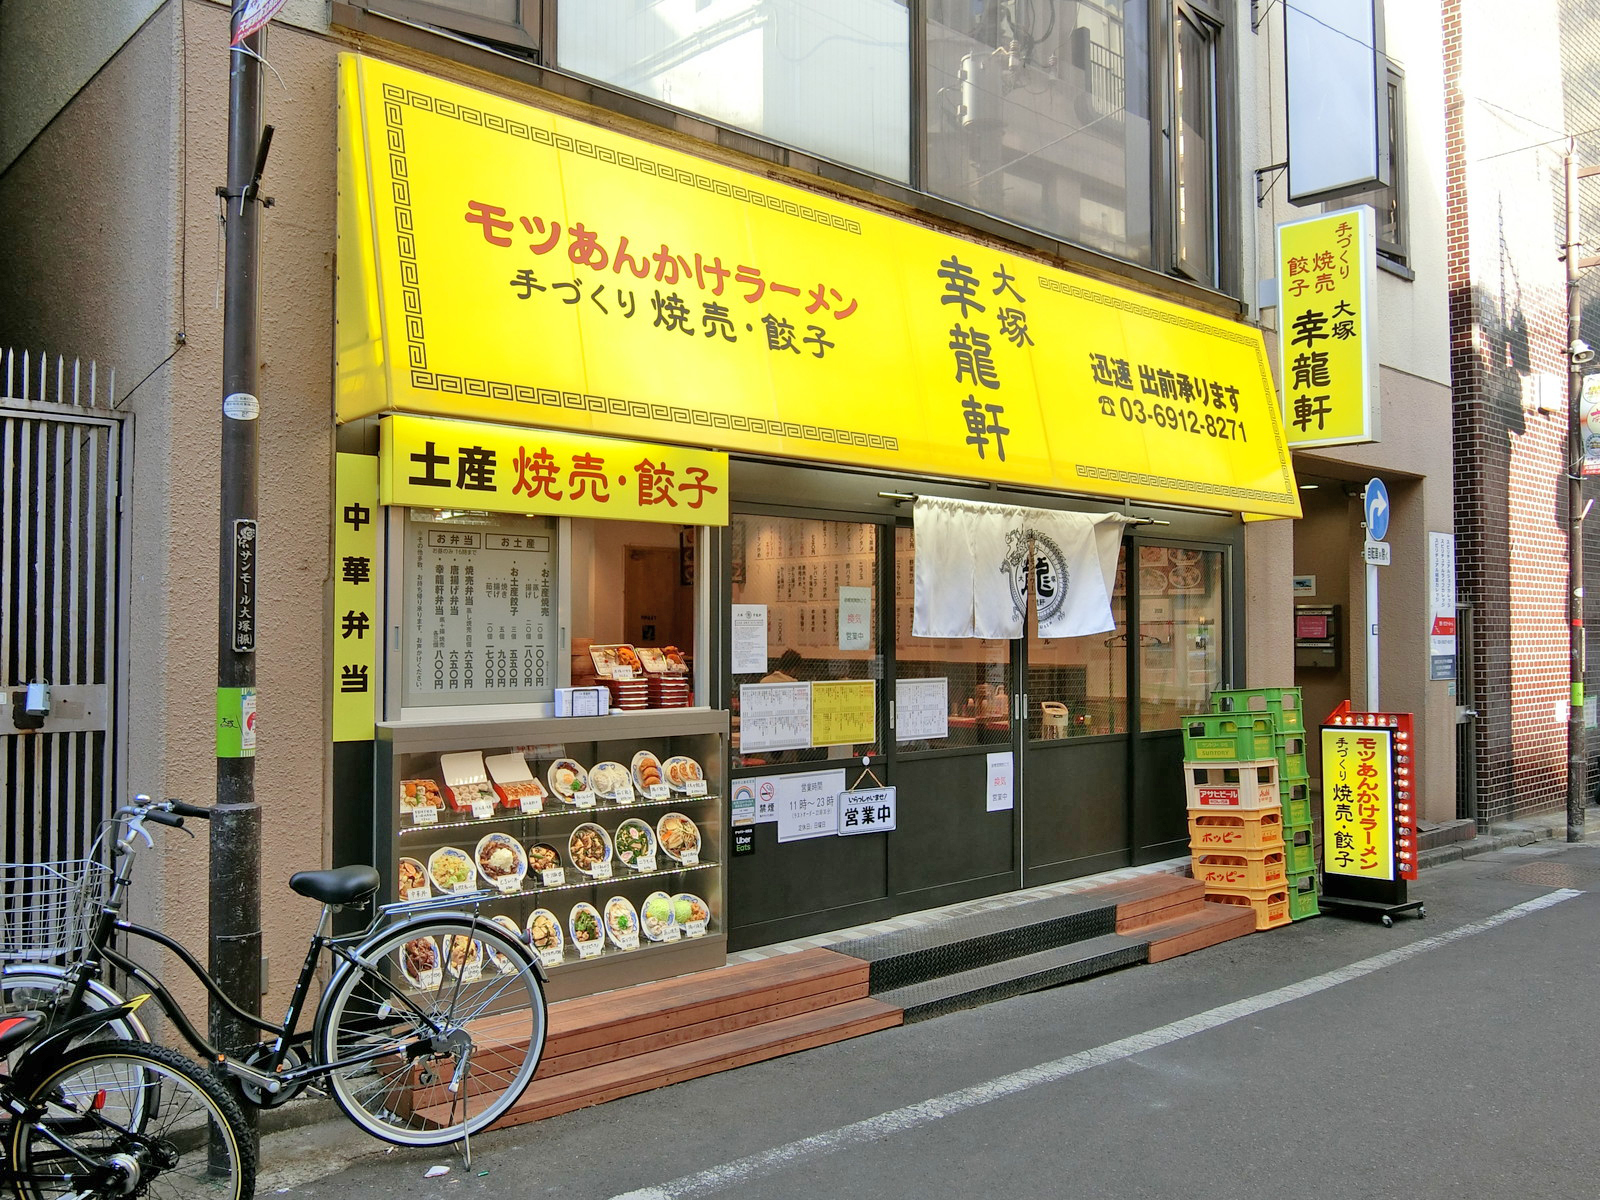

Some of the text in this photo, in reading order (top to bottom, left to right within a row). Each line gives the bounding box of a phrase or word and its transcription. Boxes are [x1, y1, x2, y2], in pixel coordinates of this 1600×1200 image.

[464, 199, 859, 321] モツあんかけラーメン
[1313, 250, 1336, 294] 焼売
[1335, 221, 1352, 280] 手づくり
[1287, 256, 1310, 297] 餃子
[509, 269, 836, 360] 手づくり 焼売・餃子
[992, 263, 1035, 349] 大塚
[1331, 299, 1357, 341] 大塚
[937, 254, 1010, 462] 幸龍軒
[1291, 309, 1332, 433] 幸龍軒
[1089, 352, 1240, 414] 迅速 出前承ります
[1120, 396, 1247, 444] 03-6912-8271
[408, 441, 718, 510] 土産 焼売・餃子
[436, 534, 474, 546] お弁当
[500, 537, 535, 549] お土産
[341, 503, 370, 693] 中華弁当
[450, 565, 460, 616] 唐揚げ弁当
[465, 565, 474, 606] 焼売弁当
[510, 567, 519, 617] お土産餃子
[541, 568, 550, 617] お土産焼売
[759, 803, 775, 813] 禁煙
[801, 781, 823, 793] 営業時間
[1200, 790, 1238, 799] アサヒビール
[1332, 737, 1355, 868] 手づくり 焼売・餃子
[1356, 737, 1380, 870] モツあんかけラーメン
[844, 804, 891, 827] 営業中
[1202, 831, 1242, 844] ホッピー
[736, 836, 751, 845] Uber
[736, 844, 751, 852] Eats
[1205, 870, 1245, 883] ホッピー
